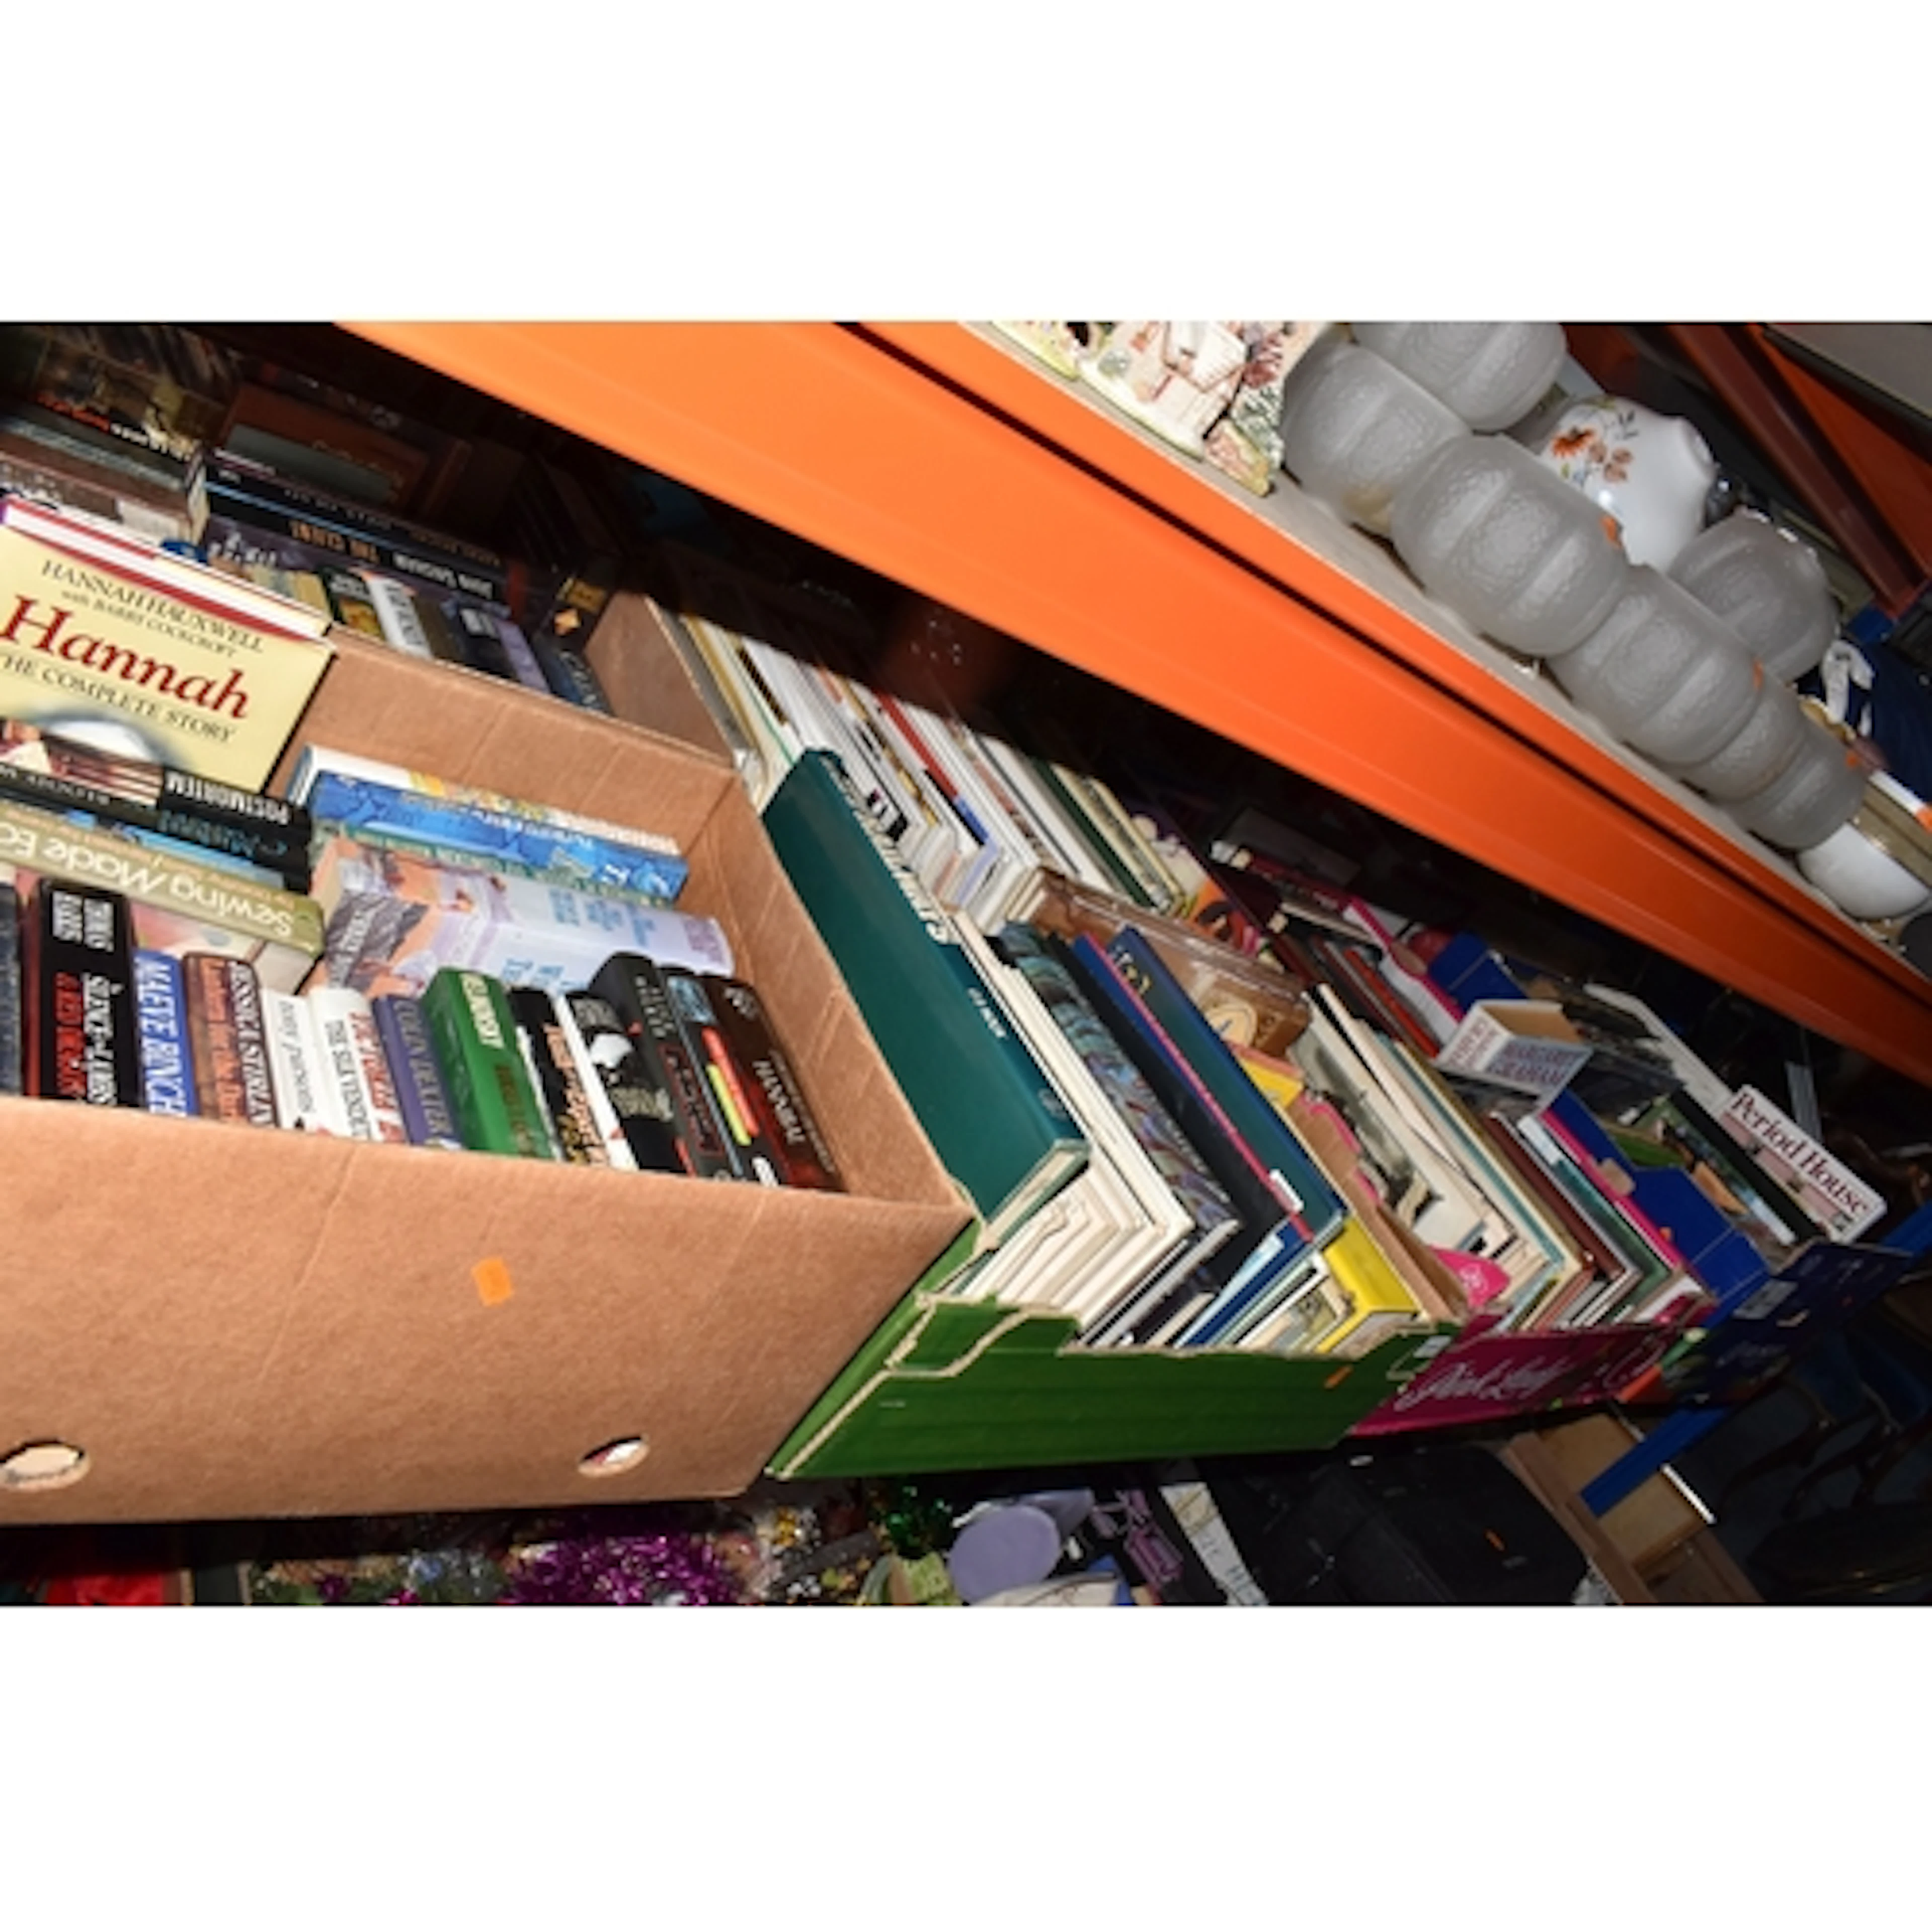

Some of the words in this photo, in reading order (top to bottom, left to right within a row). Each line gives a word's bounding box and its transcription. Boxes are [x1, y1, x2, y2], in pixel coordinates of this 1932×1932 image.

[0, 594, 250, 719] Hannah
[0, 653, 35, 678] HE
[42, 663, 158, 718] COMPLETE
[166, 708, 235, 744] STORY
[44, 836, 167, 896] Made
[170, 874, 293, 938] Sewing
[133, 957, 177, 1037] MAEVE
[141, 1038, 188, 1117] BINCH
[1731, 1092, 1807, 1158] Period
[1799, 1151, 1868, 1213] House
